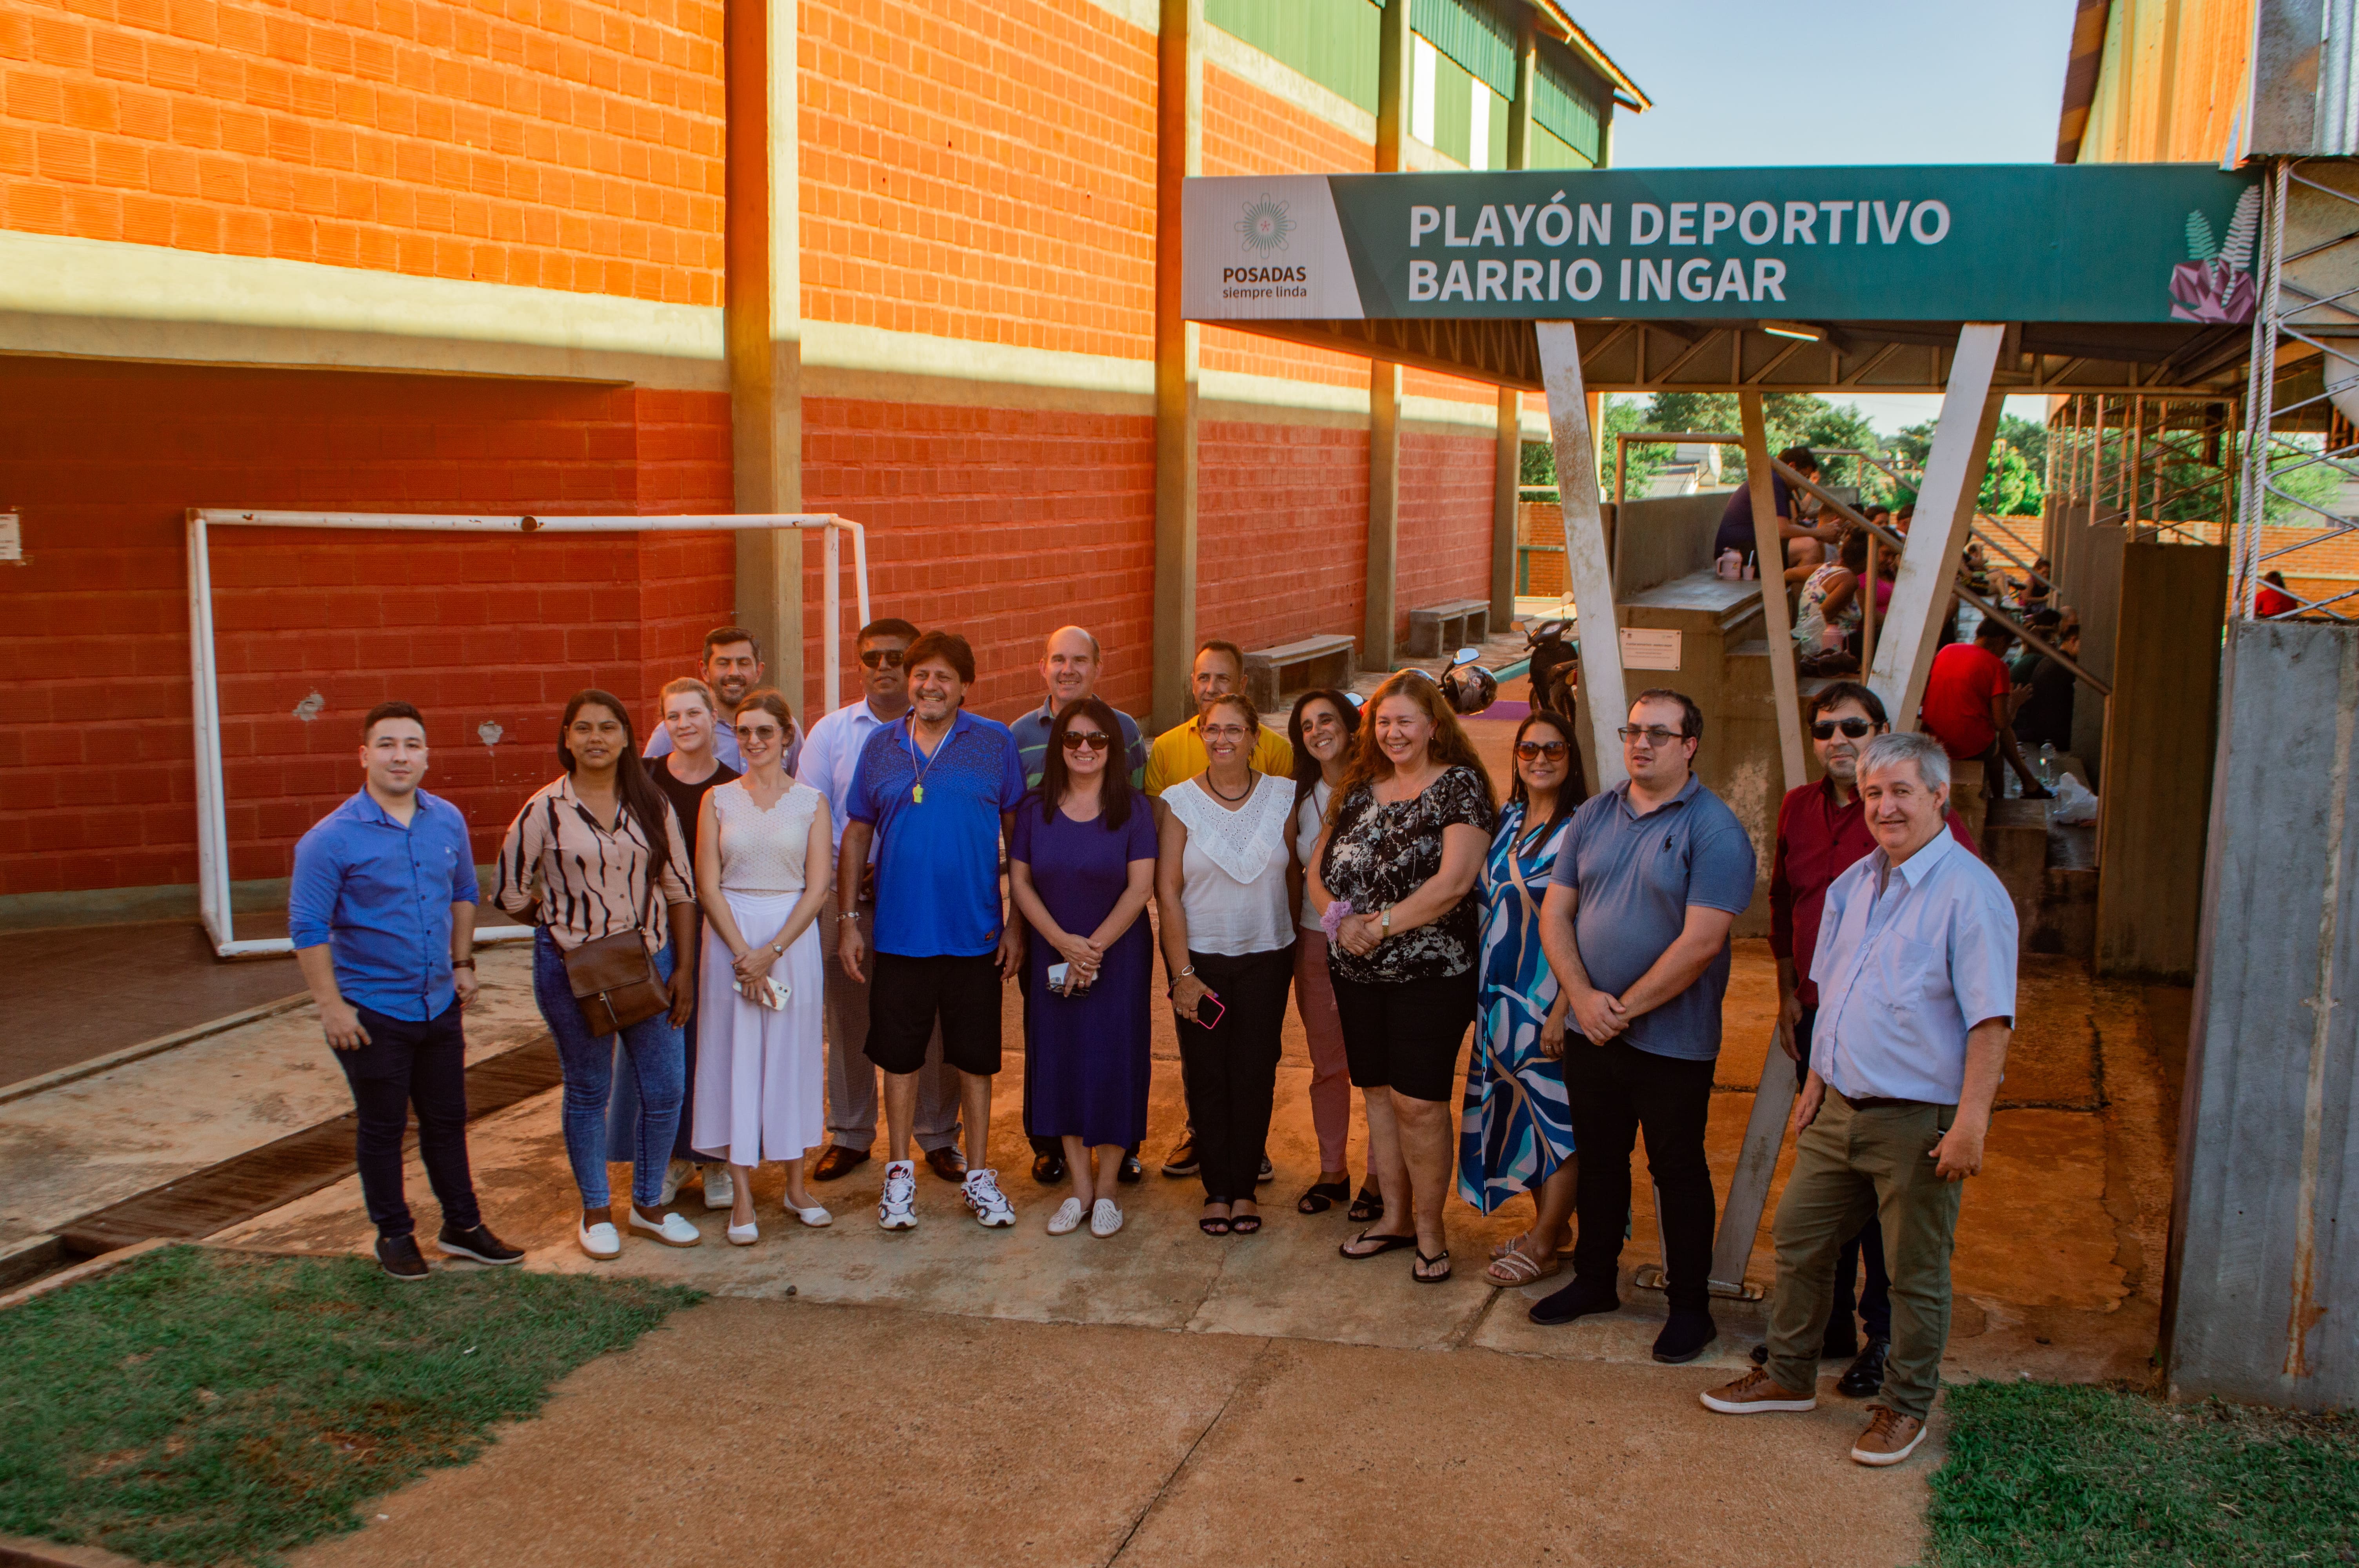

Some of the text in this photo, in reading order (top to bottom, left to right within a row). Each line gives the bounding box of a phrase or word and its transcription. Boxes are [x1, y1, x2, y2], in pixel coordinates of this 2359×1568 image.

[1410, 189, 1951, 247] PLAYÓN DEPORTIVO
[1223, 266, 1307, 283] POSADAS
[1408, 258, 1787, 302] BARRIO INGAR
[1223, 286, 1307, 300] siempre linda
